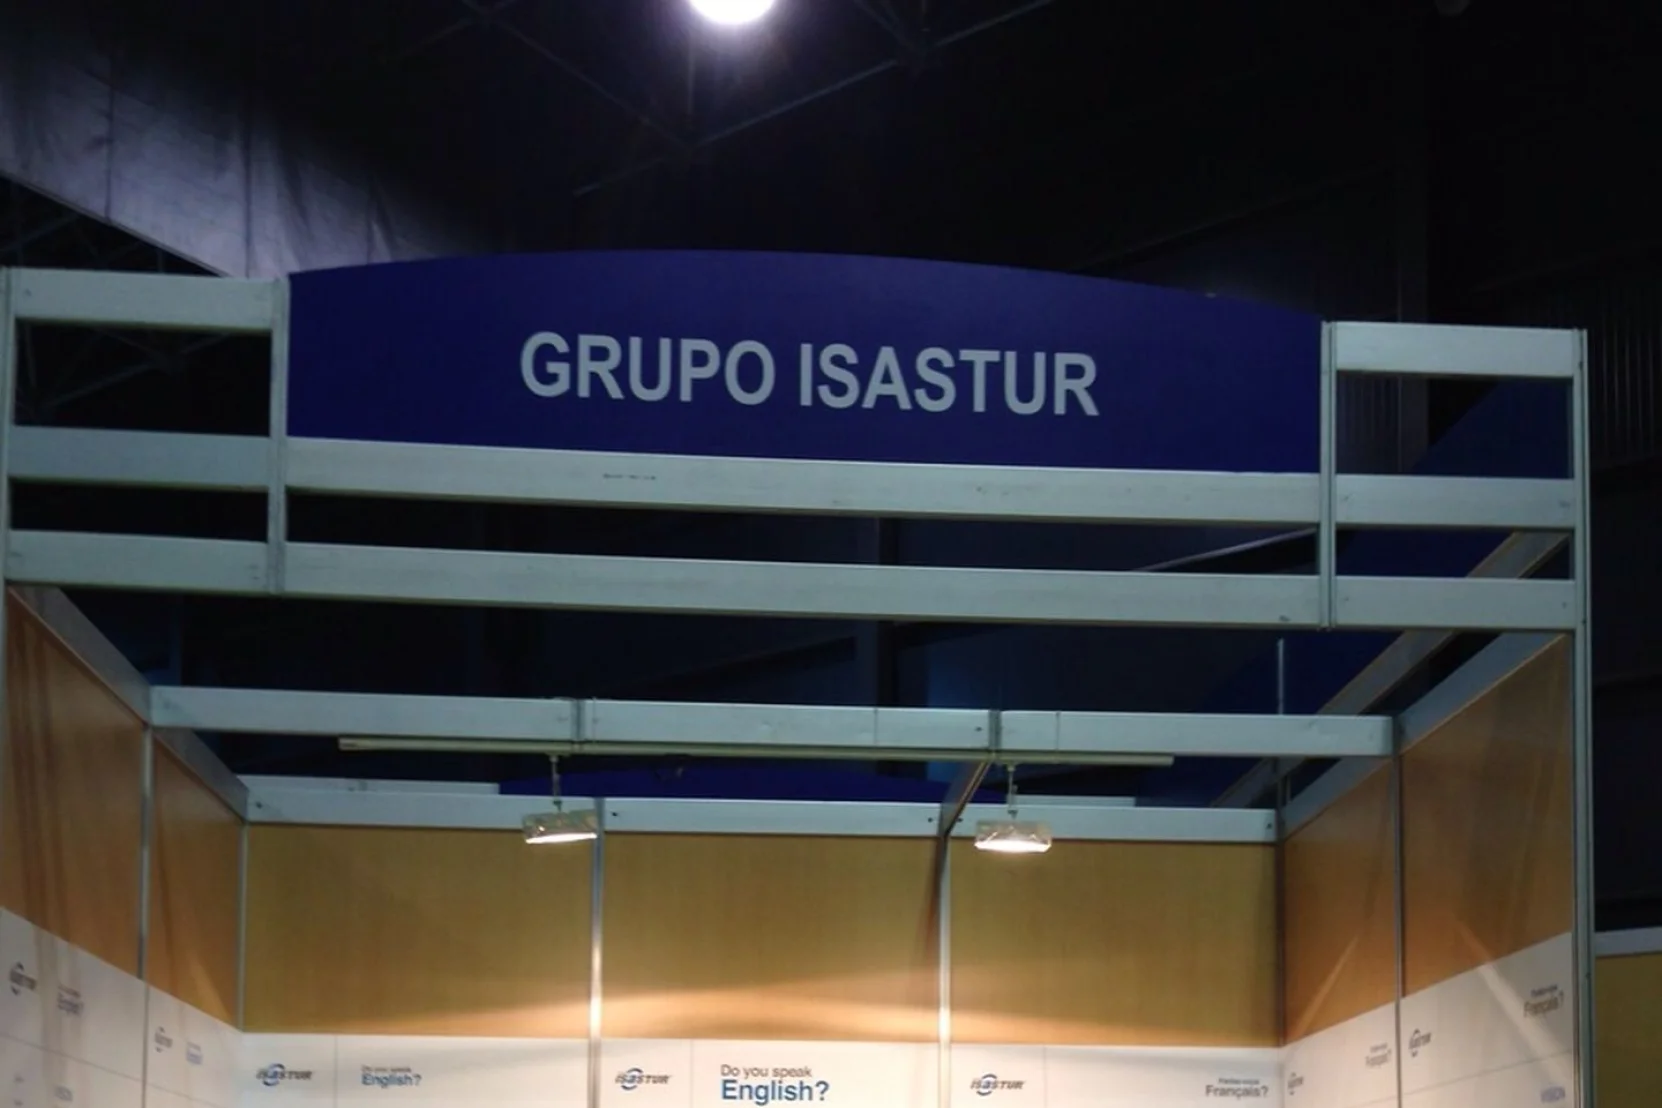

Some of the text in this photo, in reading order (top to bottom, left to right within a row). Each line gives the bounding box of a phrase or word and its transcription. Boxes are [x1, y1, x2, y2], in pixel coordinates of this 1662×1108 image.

[520, 331, 1100, 416] GRUPO ISASTUR
[720, 1064, 812, 1079] Do you speak
[721, 1079, 830, 1106] English?
